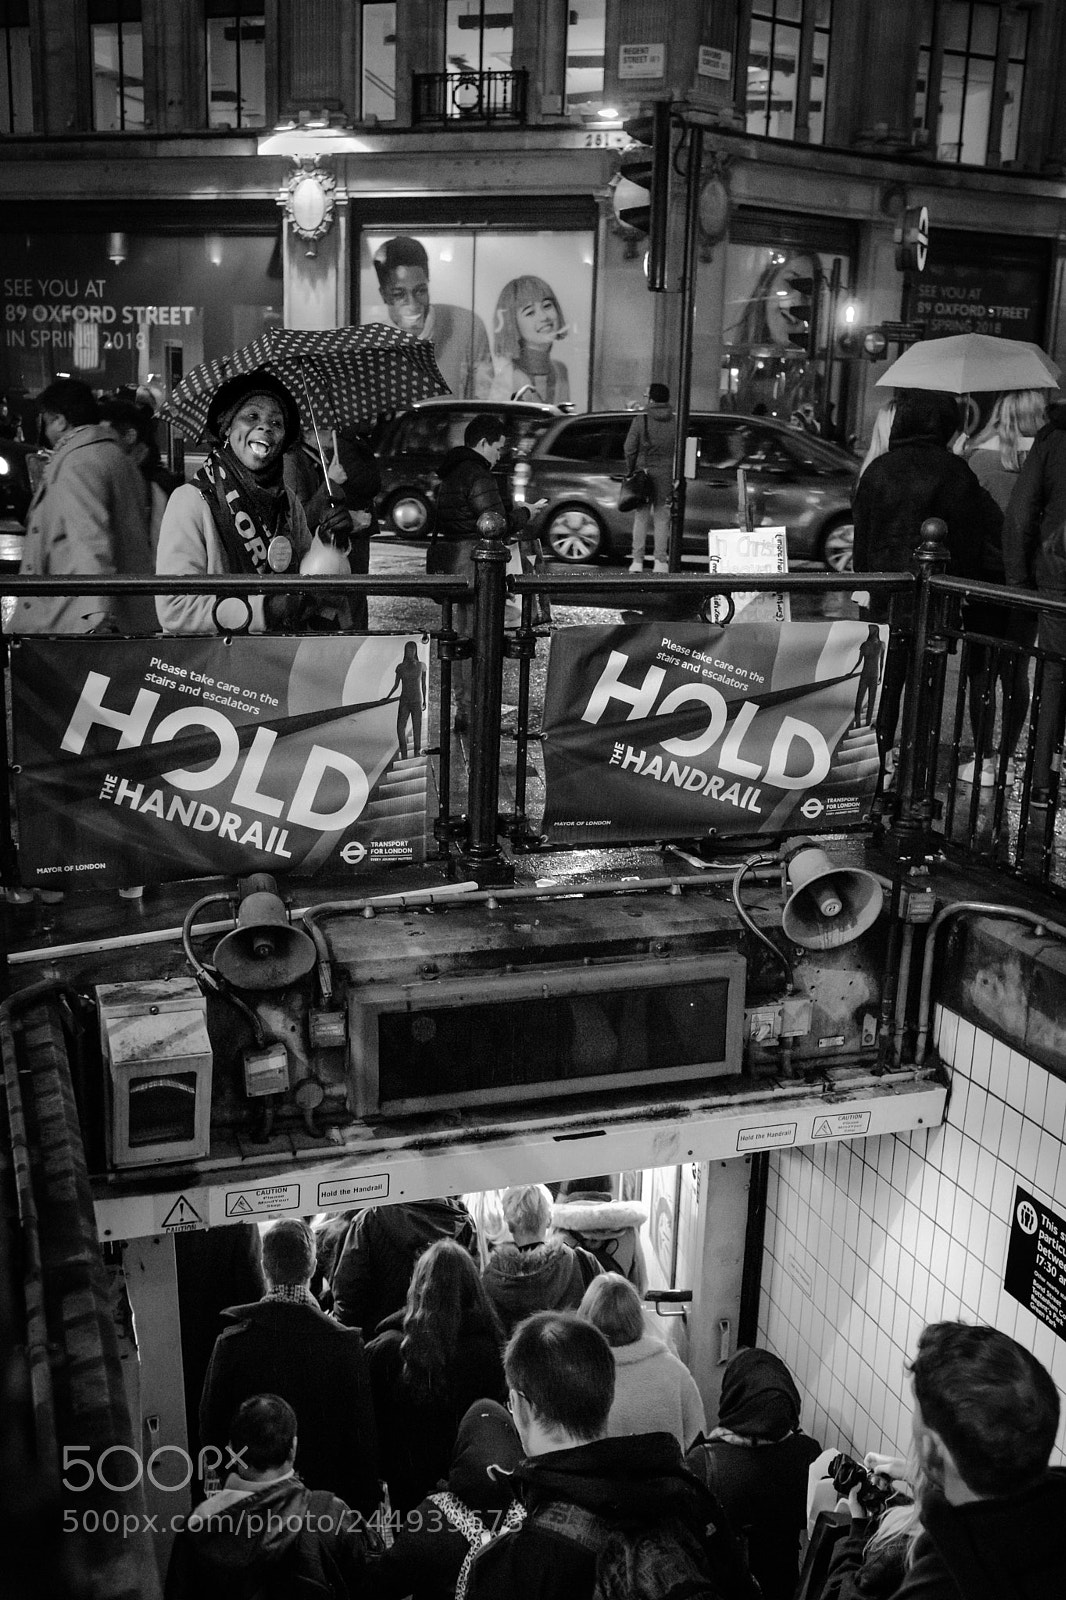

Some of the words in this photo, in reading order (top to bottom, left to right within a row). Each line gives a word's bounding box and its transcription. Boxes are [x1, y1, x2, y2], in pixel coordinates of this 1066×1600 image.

[4, 279, 32, 296] SEE
[37, 279, 78, 297] YOU
[84, 279, 106, 297] AT
[918, 284, 937, 297] SEE
[940, 286, 966, 299] YOU
[967, 288, 982, 300] AT
[5, 304, 27, 322] 89
[32, 304, 116, 322] OXFORD
[122, 306, 194, 325] STREET
[917, 302, 932, 313] 89
[934, 302, 986, 317] OXFORD
[988, 306, 1031, 320] STREET
[6, 330, 24, 346] IN
[102, 332, 146, 350] 2018
[656, 652, 680, 666] stairs
[681, 661, 701, 673] and
[702, 669, 749, 691] escalators
[661, 638, 690, 656] Please
[692, 650, 712, 664] take
[714, 660, 734, 672] care
[735, 668, 748, 677] on
[749, 672, 765, 684] the
[150, 657, 188, 678] Please
[190, 671, 214, 686] take
[216, 681, 240, 694] care
[242, 689, 257, 700] on
[260, 693, 279, 706] the
[144, 673, 176, 689] stairs
[178, 684, 201, 696] and
[202, 691, 261, 715] escalators
[581, 650, 830, 790] HOLD
[60, 670, 369, 831] HOLD
[609, 742, 625, 765] THE
[98, 773, 119, 800] THE
[621, 745, 762, 813] HANDRAIL
[114, 778, 296, 858] HANDRAIL
[36, 866, 62, 874] MAYOR
[75, 863, 106, 871] LONDON
[740, 1133, 754, 1141] Hold
[756, 1132, 764, 1140] the
[767, 1130, 792, 1138] Handrail
[256, 1187, 288, 1196] CAUTION
[353, 1184, 383, 1193] Handrail
[1041, 1213, 1058, 1235] This
[1036, 1254, 1057, 1277] 17:30
[1033, 1278, 1046, 1294] Bond
[1031, 1294, 1052, 1316] Regent's
[1053, 1312, 1063, 1326] Park
[1032, 1286, 1058, 1313] Tottenham
[1030, 1302, 1045, 1318] Green
[1046, 1315, 1056, 1328] Park
